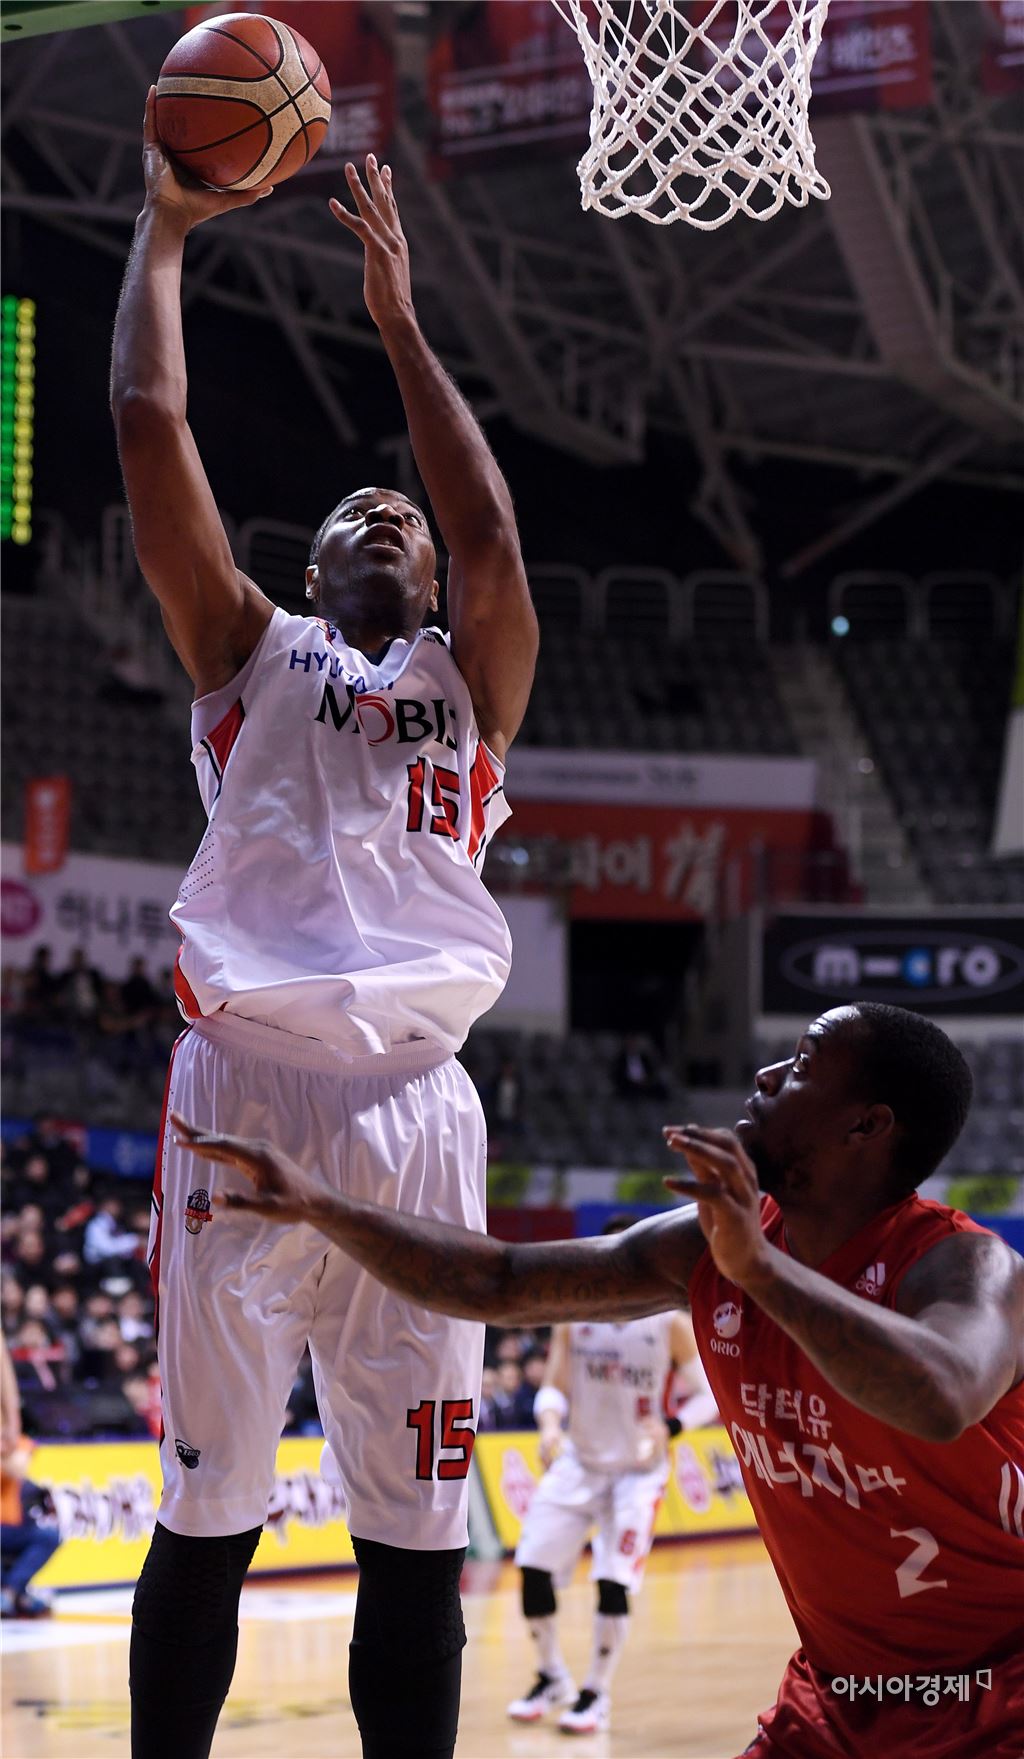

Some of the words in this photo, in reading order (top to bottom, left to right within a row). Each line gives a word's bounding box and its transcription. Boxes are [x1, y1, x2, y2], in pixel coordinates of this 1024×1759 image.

[406, 755, 461, 842] 15
[710, 1338, 741, 1359] ORIO
[406, 1398, 476, 1481] 15
[740, 1382, 832, 1440] 닥터유
[890, 1526, 948, 1599] 2
